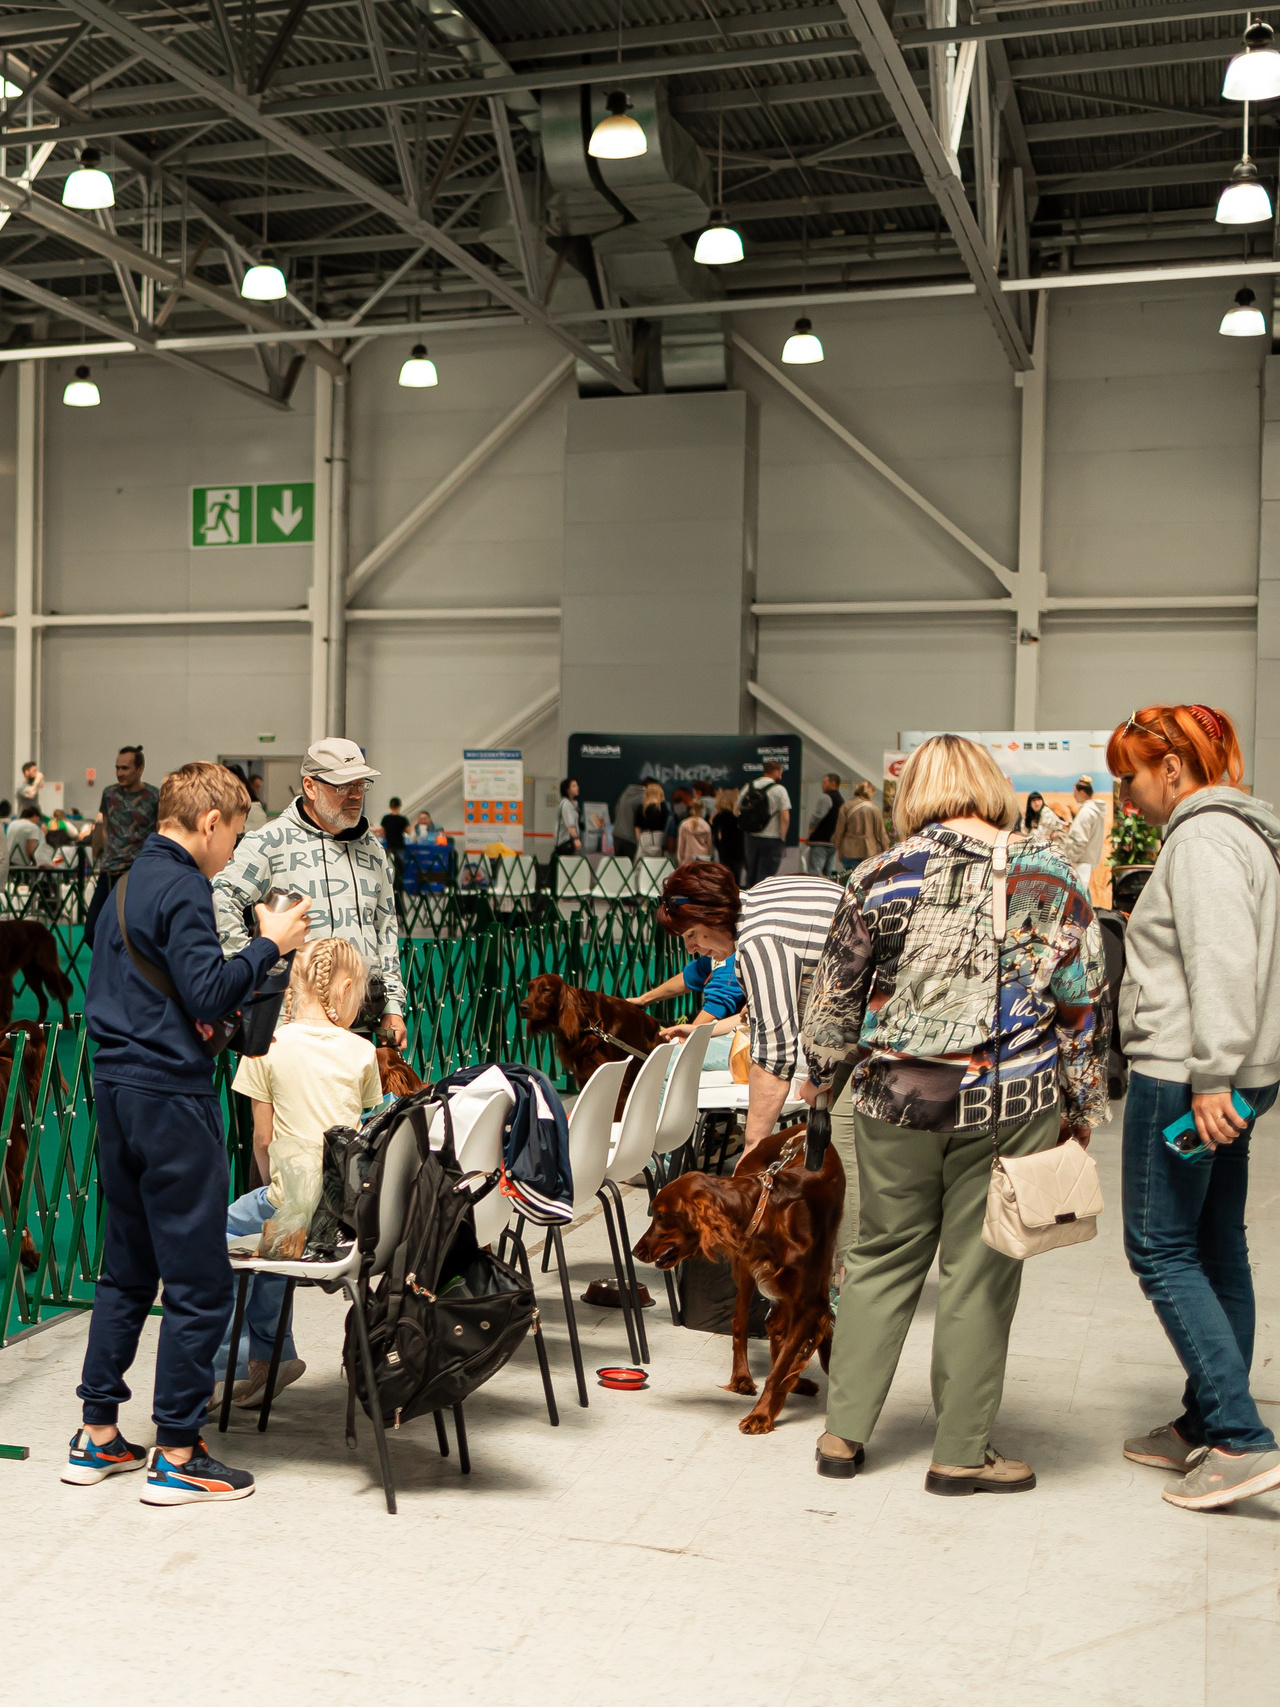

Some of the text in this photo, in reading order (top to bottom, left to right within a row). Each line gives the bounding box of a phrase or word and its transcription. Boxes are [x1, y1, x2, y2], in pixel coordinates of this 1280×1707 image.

[581, 745, 621, 755] AlphaPet
[639, 762, 730, 784] AlphaPet
[954, 1067, 1058, 1129] BBB
